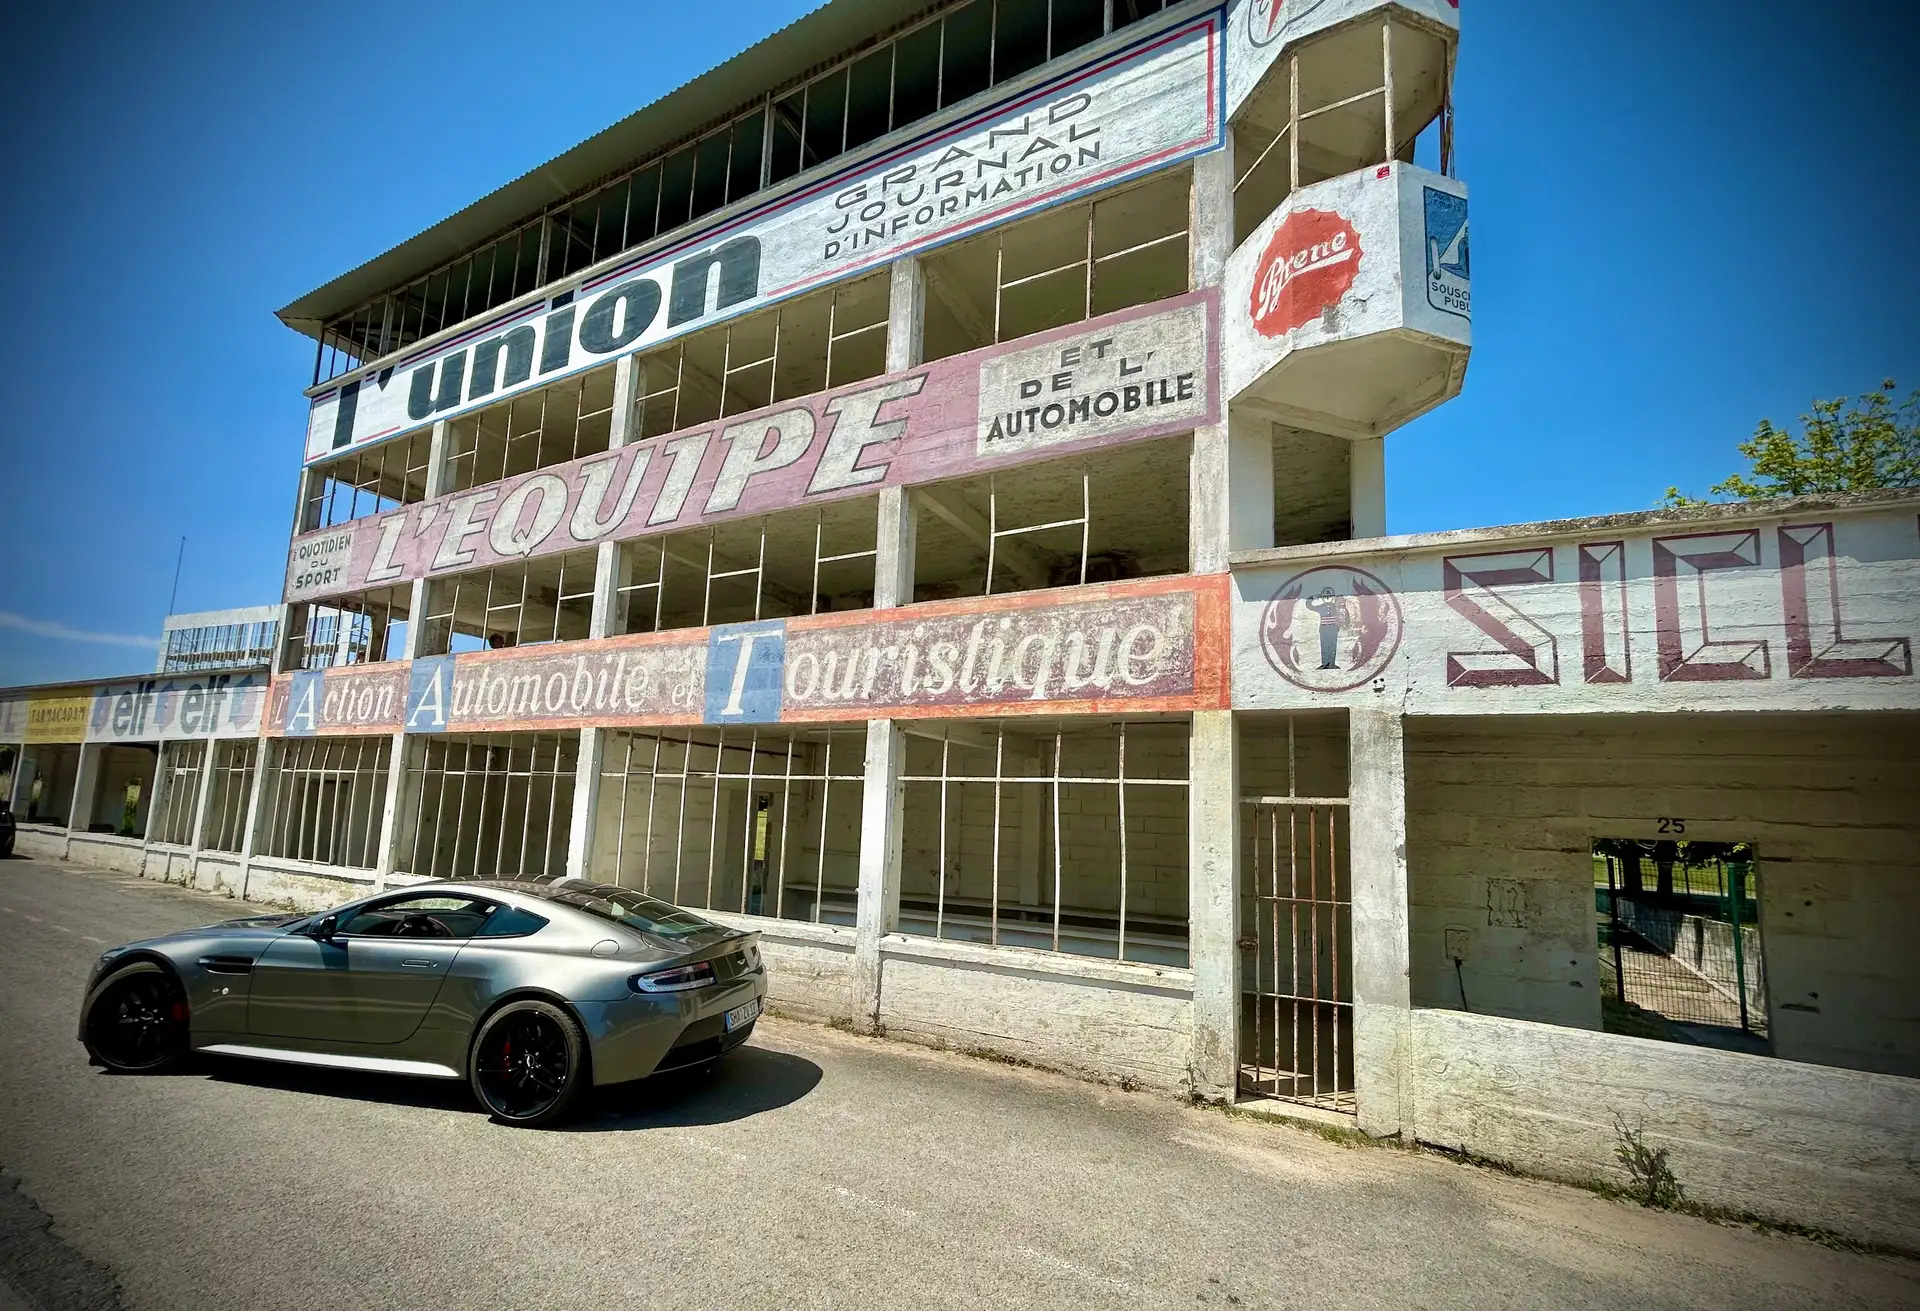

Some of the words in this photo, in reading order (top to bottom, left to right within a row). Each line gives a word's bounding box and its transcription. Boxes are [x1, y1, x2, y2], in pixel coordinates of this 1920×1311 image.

[827, 125, 1101, 234] JOURNAL
[834, 93, 1092, 210] GRAND
[824, 141, 1101, 260] D'INFORMATION
[1431, 281, 1471, 302] SOUSC
[332, 235, 762, 450] l'union
[1020, 371, 1072, 399] DE
[1119, 351, 1154, 377] L'
[1061, 337, 1113, 368] ET
[986, 372, 1194, 443] AUTOMOBILE
[364, 371, 931, 585] L'EQUIPE
[296, 567, 341, 589] SPORT
[300, 534, 351, 559] QUOTIDIEN
[311, 558, 328, 568] DU
[1443, 521, 1920, 688] SICL
[113, 679, 156, 737] elf
[181, 674, 230, 734] elf
[407, 653, 651, 727] Automobile
[717, 617, 1166, 716] Touristique
[1657, 817, 1685, 834] 25
